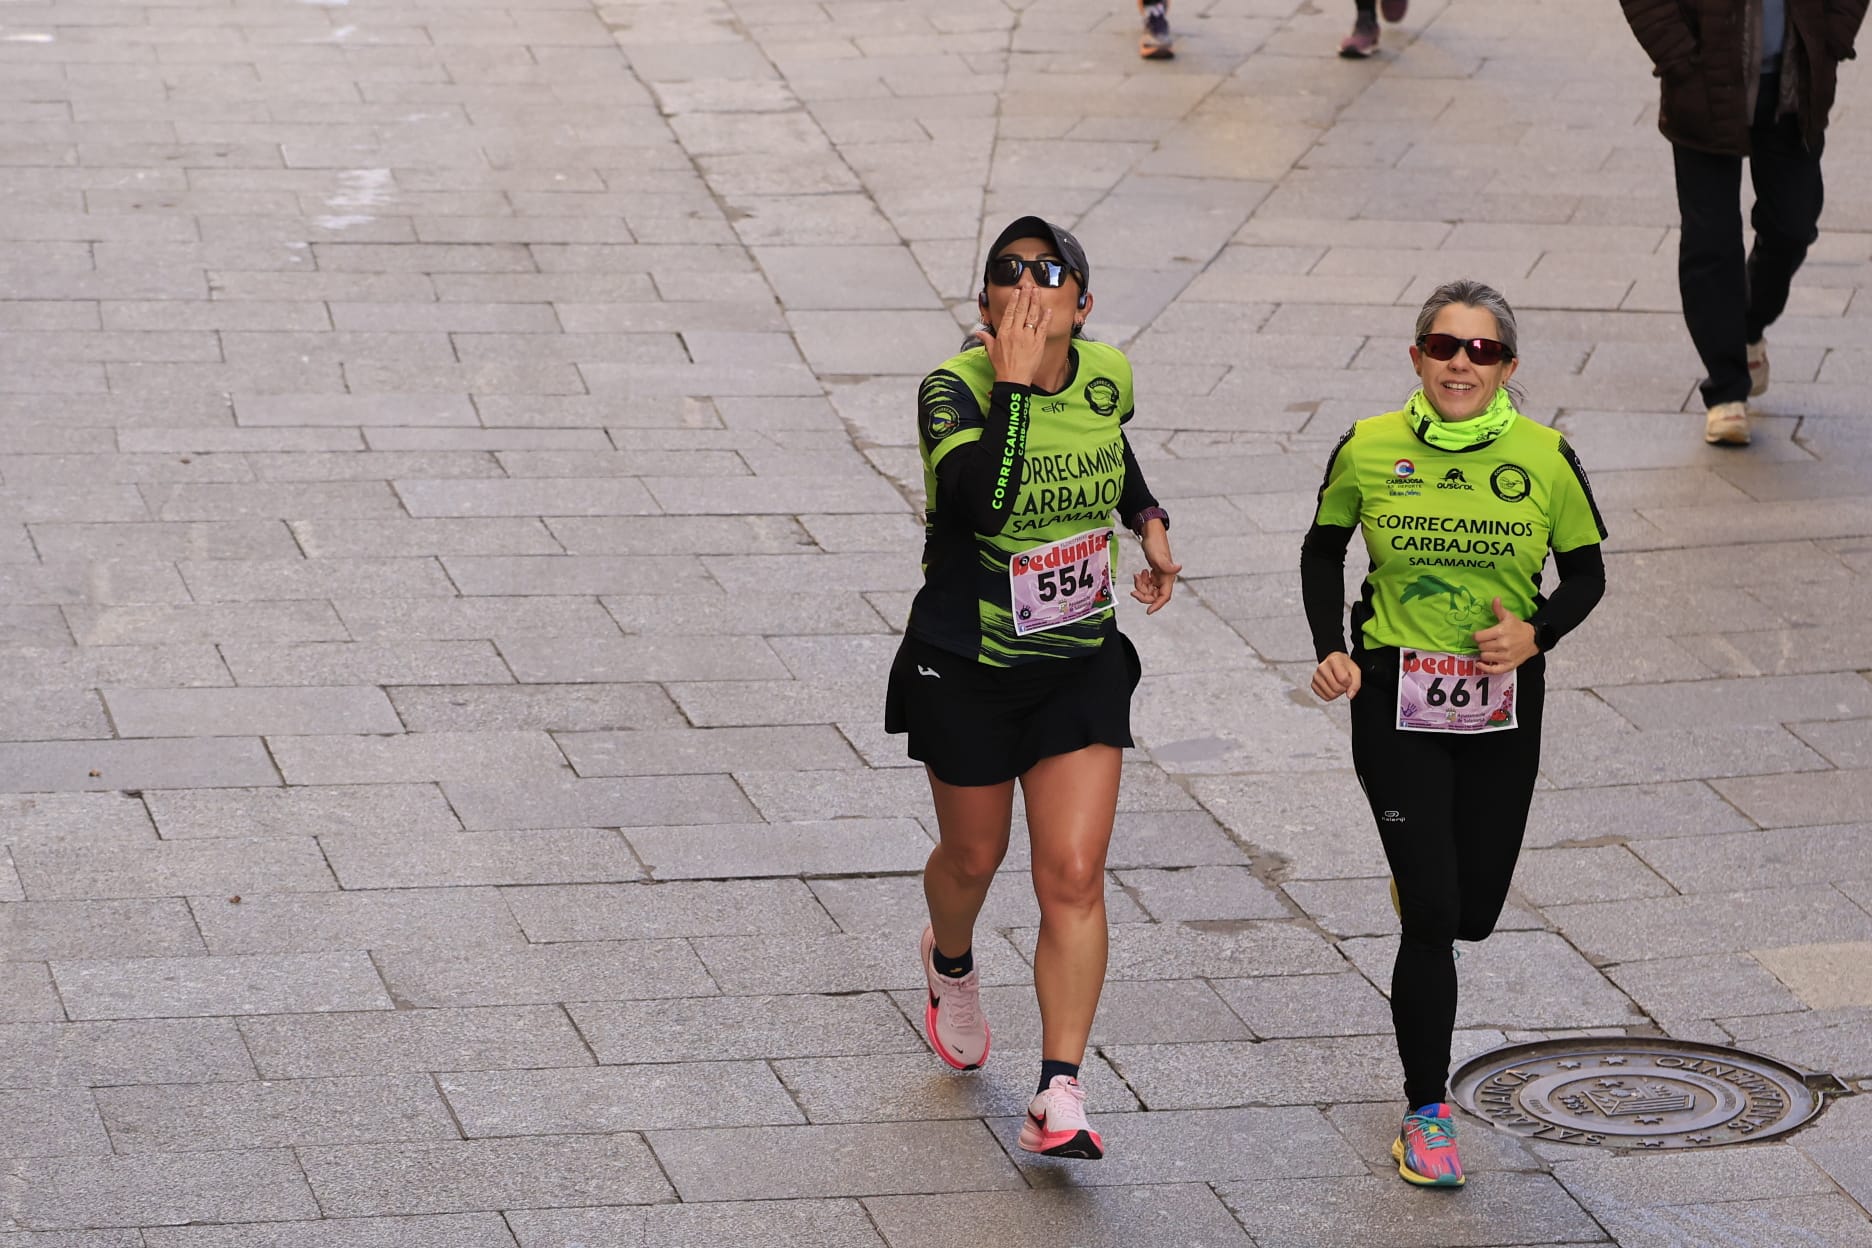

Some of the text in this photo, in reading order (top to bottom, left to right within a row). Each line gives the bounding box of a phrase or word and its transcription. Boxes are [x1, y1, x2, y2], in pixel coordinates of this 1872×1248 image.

[991, 392, 1021, 510] CORRECAMINOS
[1021, 441, 1123, 485] ORRECAMINO
[1013, 509, 1110, 533] SALAMAN
[1377, 514, 1533, 537] CORRECAMINOS
[1391, 535, 1515, 557] CARBAJOSA
[1409, 556, 1496, 570] SALAMANCA
[1037, 559, 1094, 602] 554
[1402, 651, 1488, 677] bedu
[1426, 677, 1489, 707] 661
